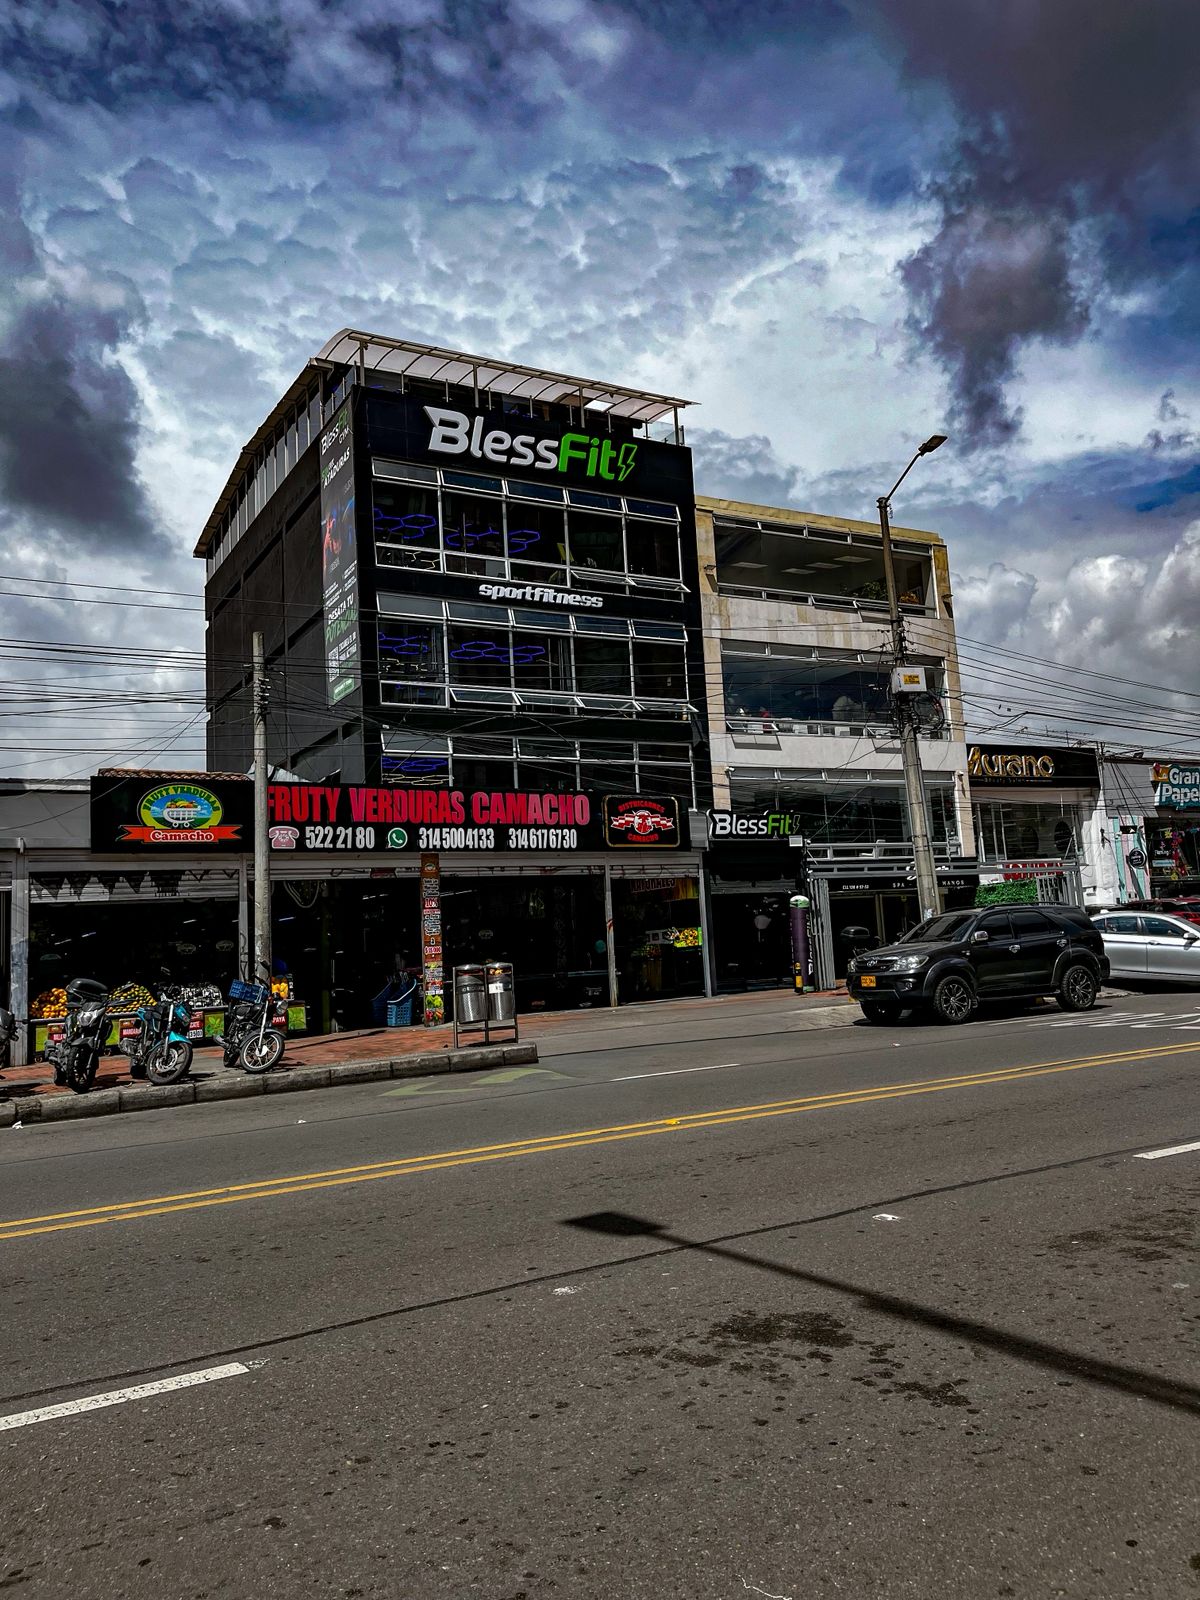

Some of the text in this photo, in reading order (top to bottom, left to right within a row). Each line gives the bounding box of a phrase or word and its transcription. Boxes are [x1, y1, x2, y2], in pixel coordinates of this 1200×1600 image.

[423, 406, 617, 480] BlessFit
[479, 584, 603, 608] sportfitness
[1169, 767, 1200, 785] Gran
[172, 785, 221, 811] VERDURAS
[1162, 783, 1200, 806] Pape
[267, 787, 591, 826] FRUTY VERDURAS CAMACHO
[150, 829, 214, 842] Camacho
[712, 813, 792, 835] BlessFit
